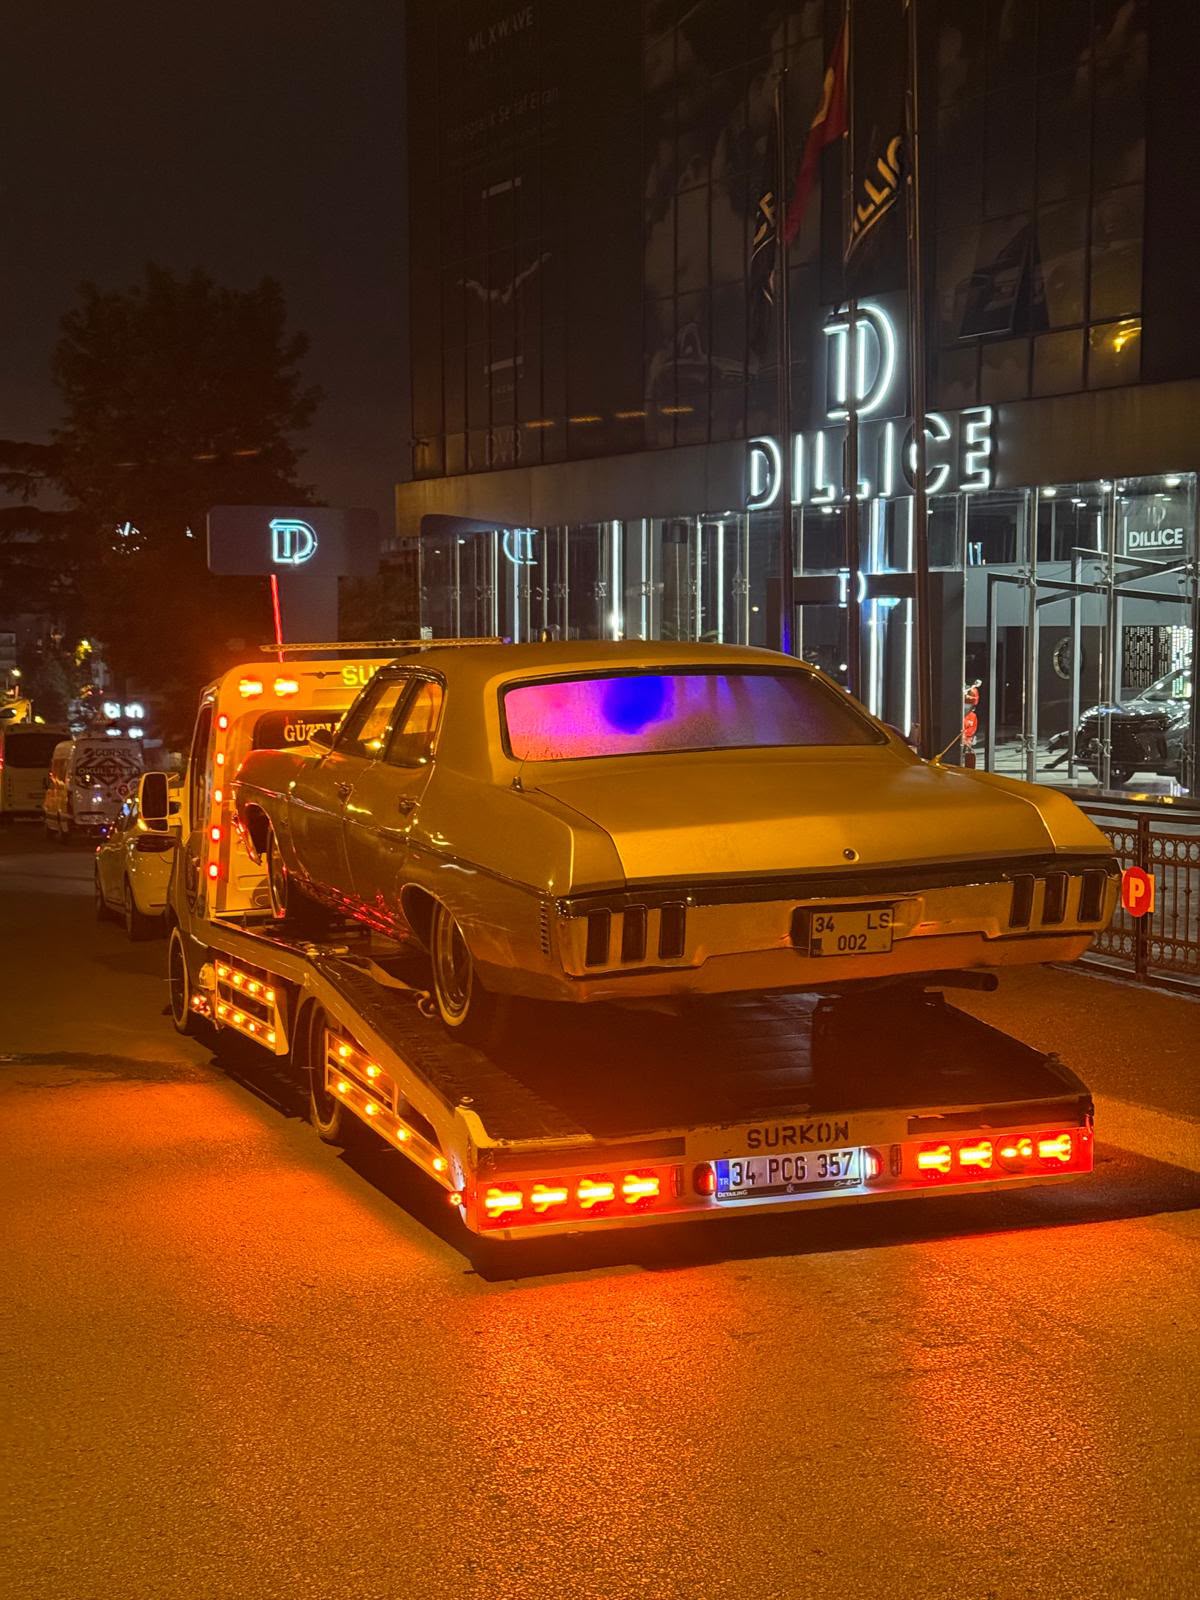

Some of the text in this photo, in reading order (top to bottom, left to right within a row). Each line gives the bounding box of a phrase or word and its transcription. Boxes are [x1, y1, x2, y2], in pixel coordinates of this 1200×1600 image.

[746, 405, 997, 511] DILLICE
[1128, 528, 1183, 547] DILLICE
[341, 664, 379, 685] SU
[815, 912, 890, 933] 34 LS
[837, 934, 867, 951] 002
[731, 1162, 756, 1187] 34
[768, 1156, 807, 1184] PCG
[817, 1151, 854, 1178] 357
